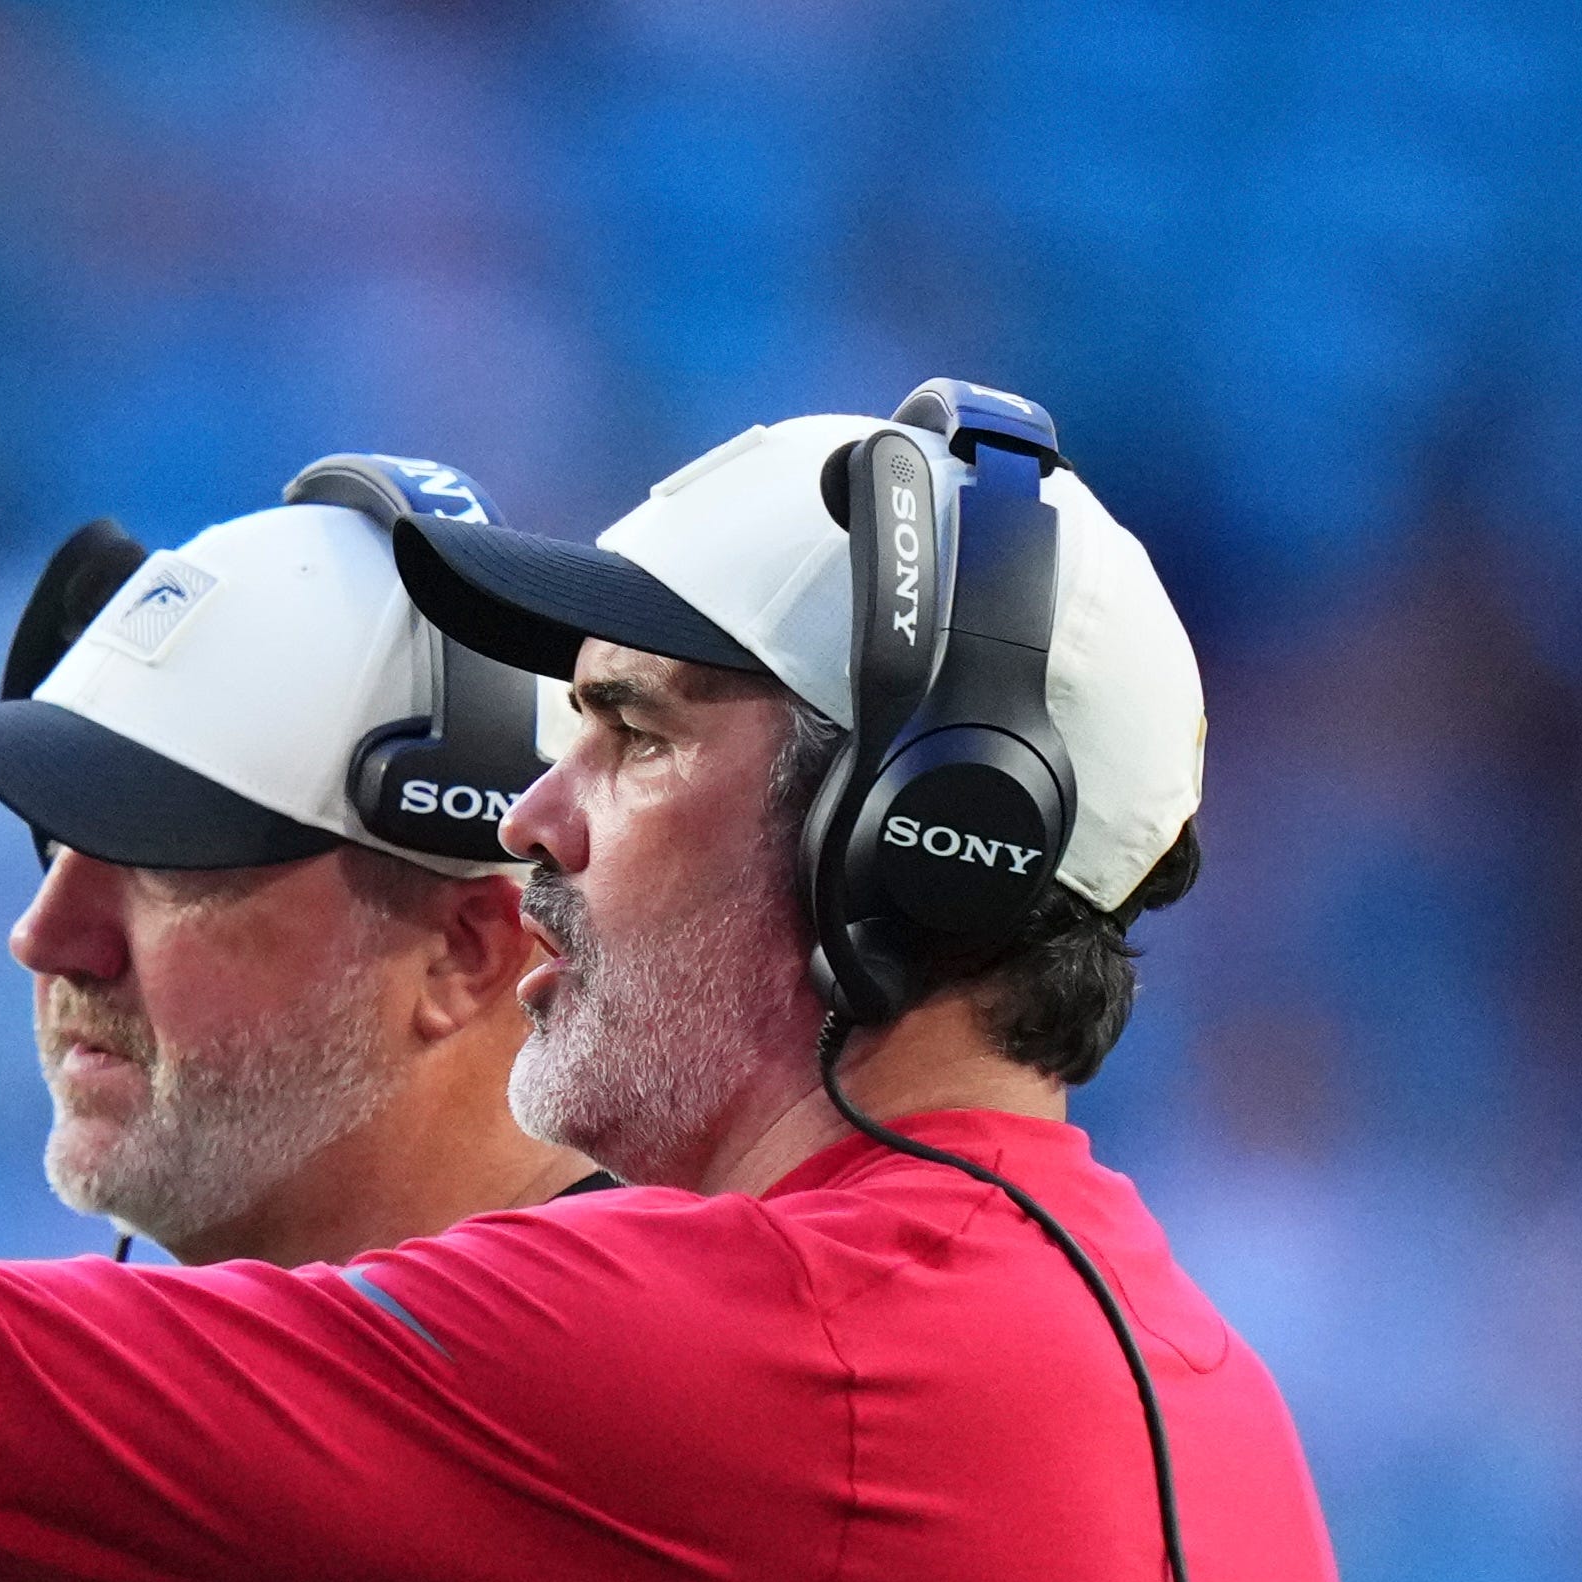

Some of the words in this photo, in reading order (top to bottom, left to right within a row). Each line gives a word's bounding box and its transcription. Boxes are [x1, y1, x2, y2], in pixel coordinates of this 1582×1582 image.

[891, 485, 919, 648] SONY
[399, 779, 524, 823] SON
[884, 815, 1043, 876] SONY
